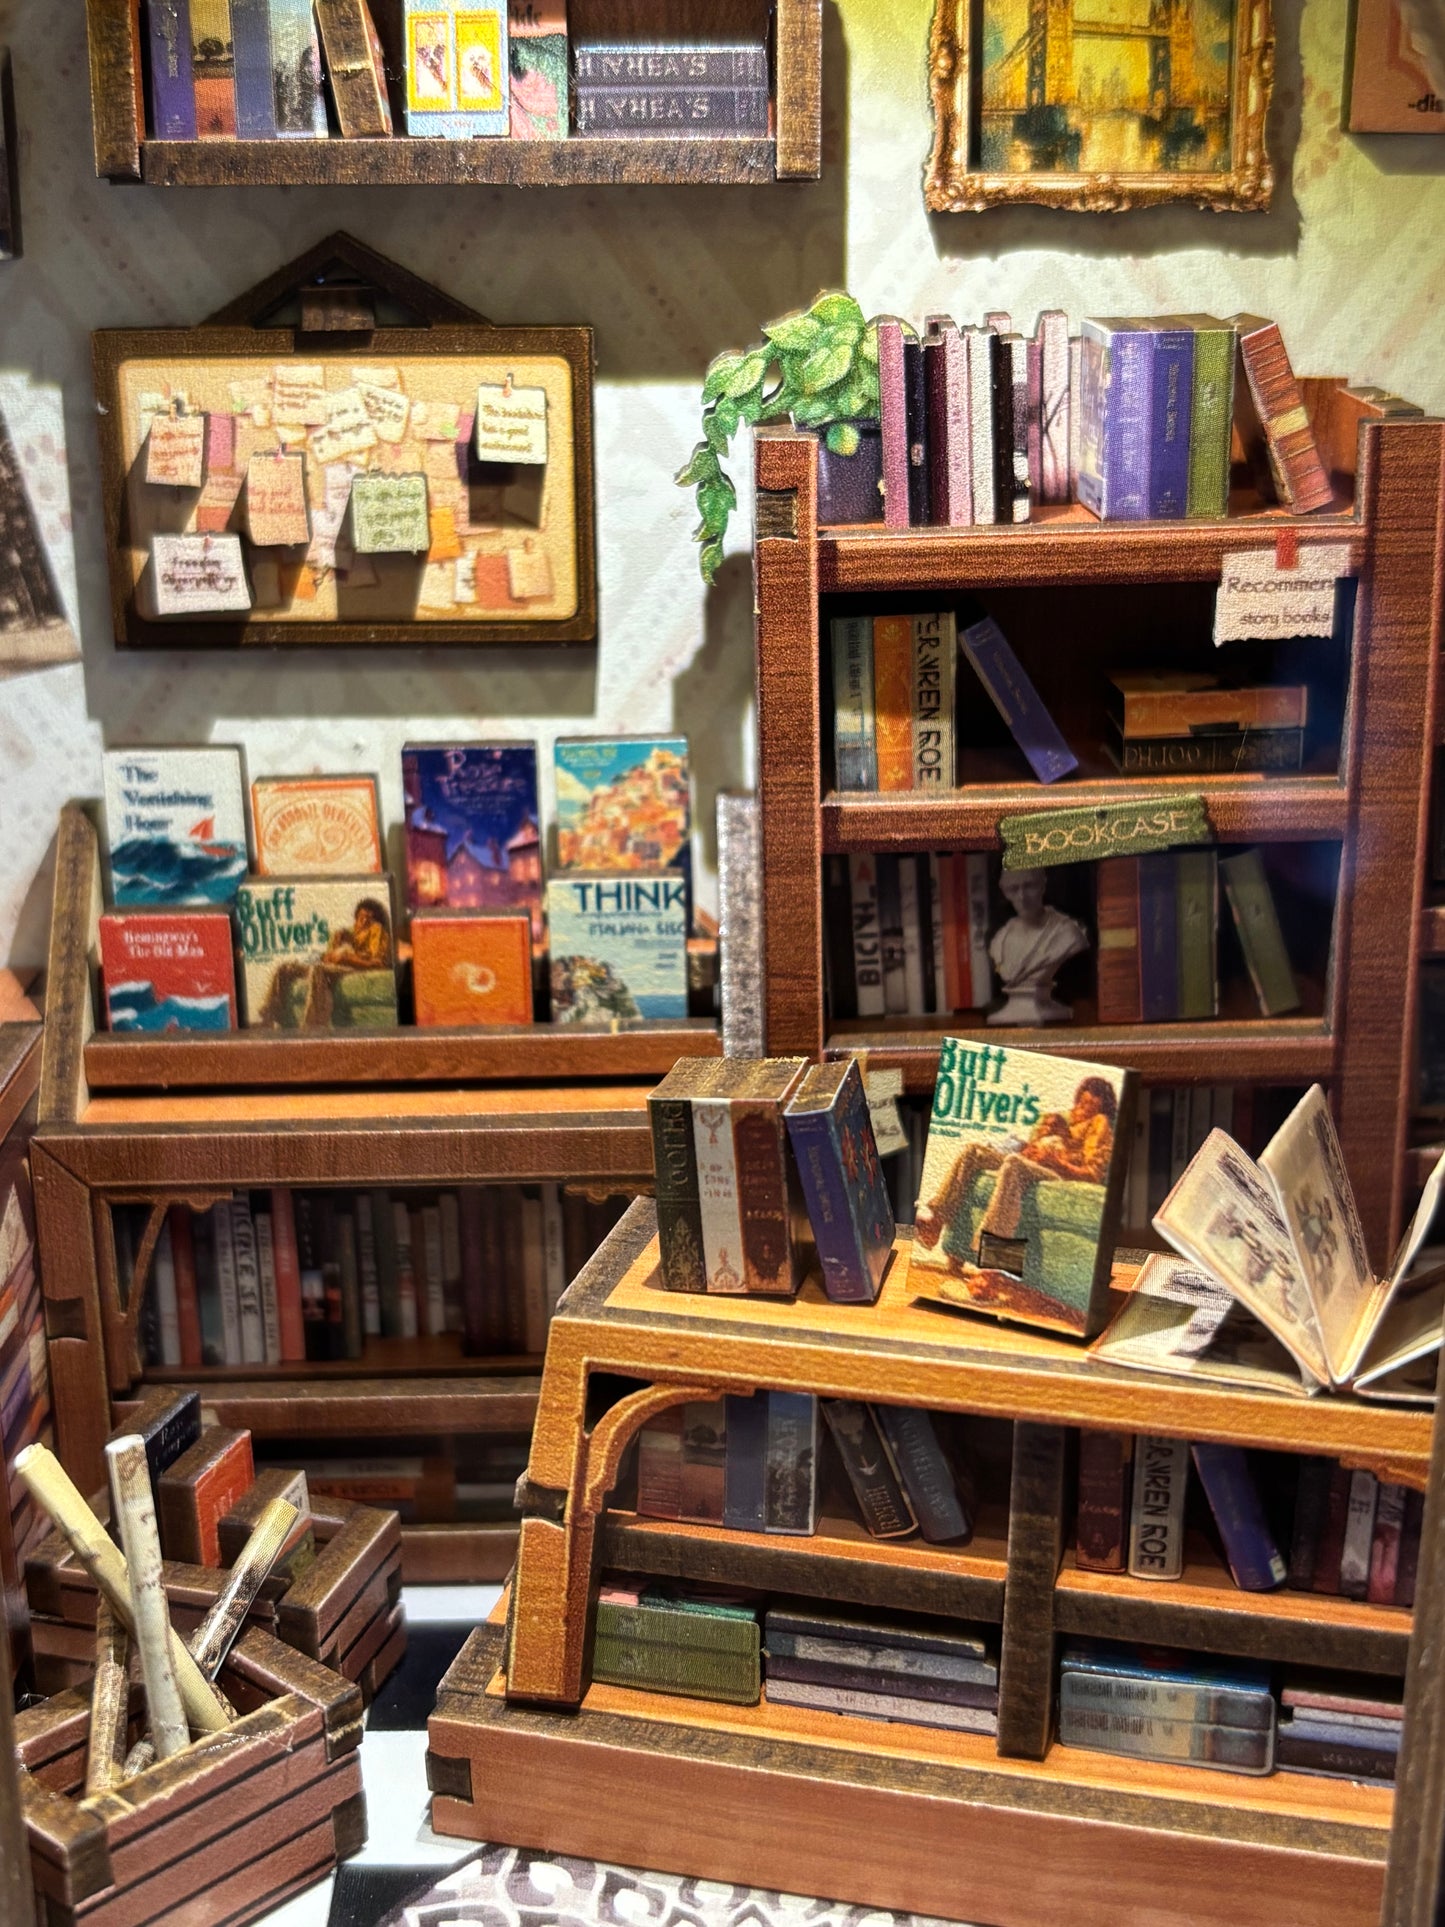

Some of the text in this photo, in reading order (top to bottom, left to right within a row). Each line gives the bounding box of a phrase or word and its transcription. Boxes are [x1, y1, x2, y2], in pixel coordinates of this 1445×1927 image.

[1025, 810, 1189, 853] BOOKCASE
[572, 882, 685, 912] THINK
[933, 1073, 1040, 1125] Oliver's
